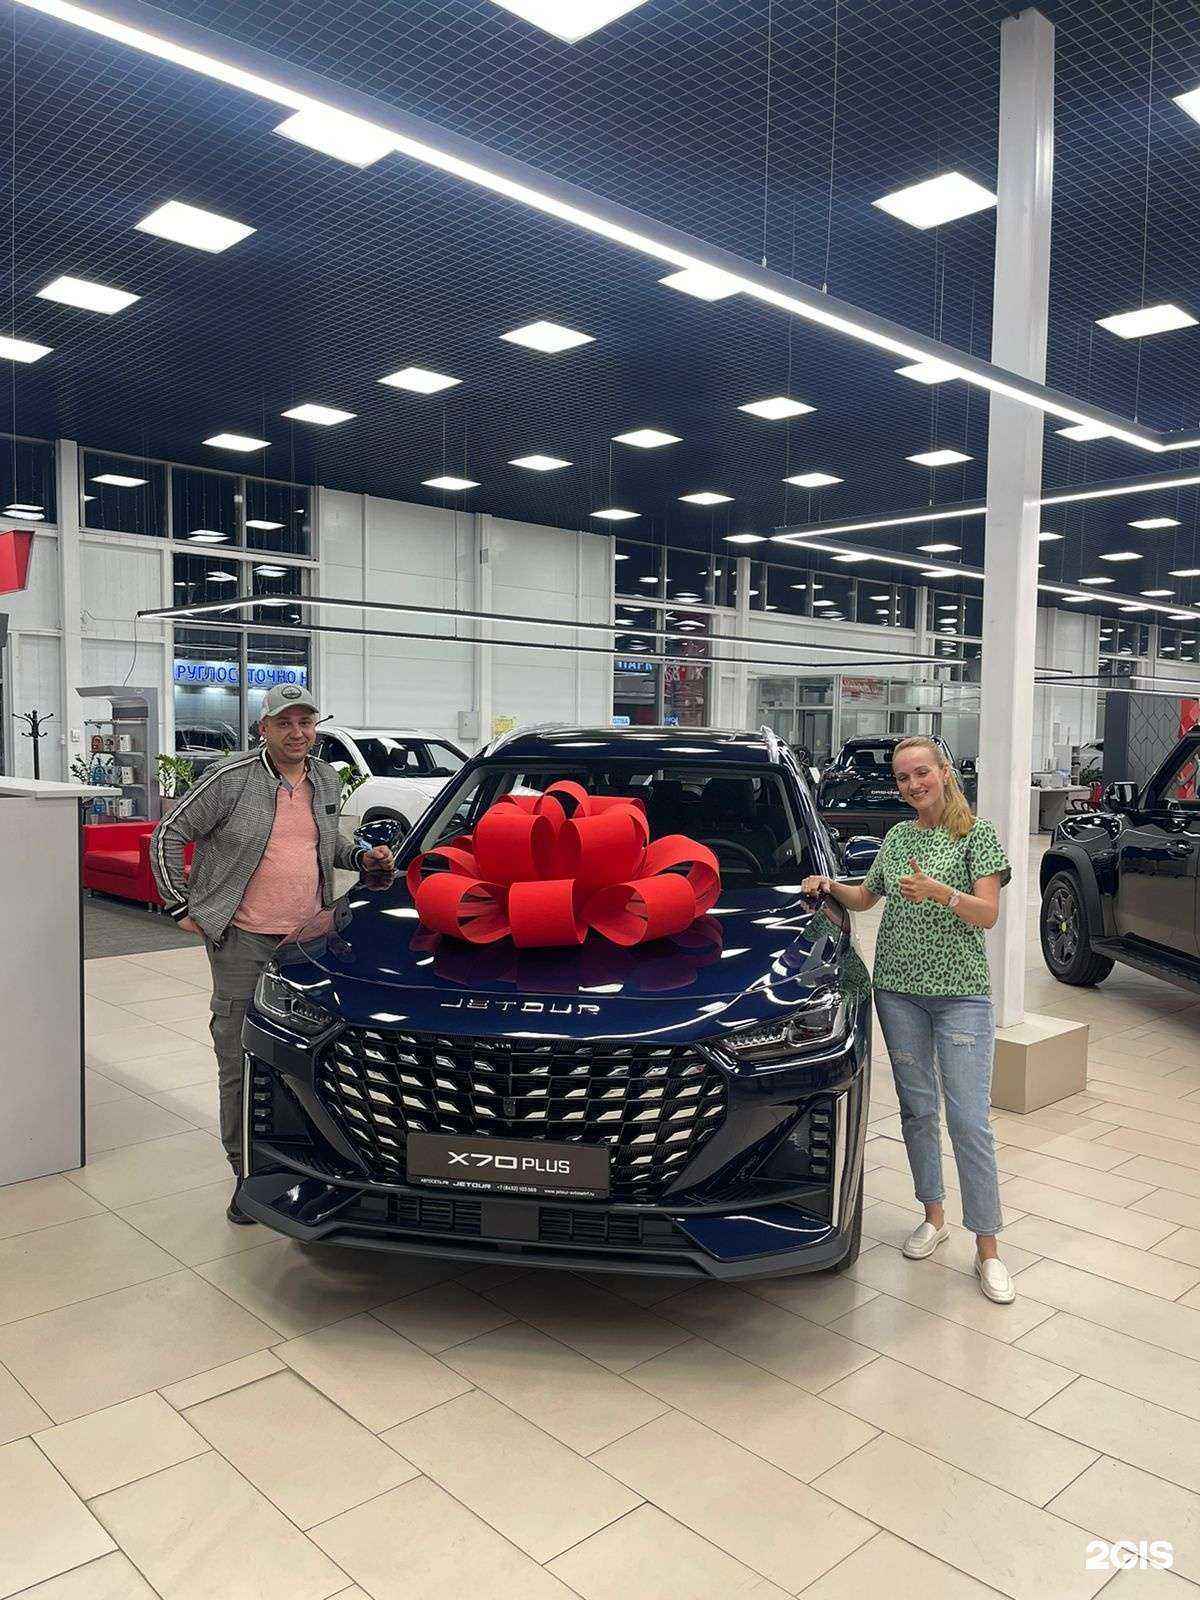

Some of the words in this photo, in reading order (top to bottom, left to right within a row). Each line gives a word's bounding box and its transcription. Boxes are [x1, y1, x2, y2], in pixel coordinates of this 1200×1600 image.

[174, 664, 296, 684] РУГЛОСТОЧНО
[440, 998, 600, 1015] JETOUR
[447, 1151, 518, 1169] X70
[522, 1158, 570, 1174] PLUS
[453, 1180, 491, 1189] JETOUR
